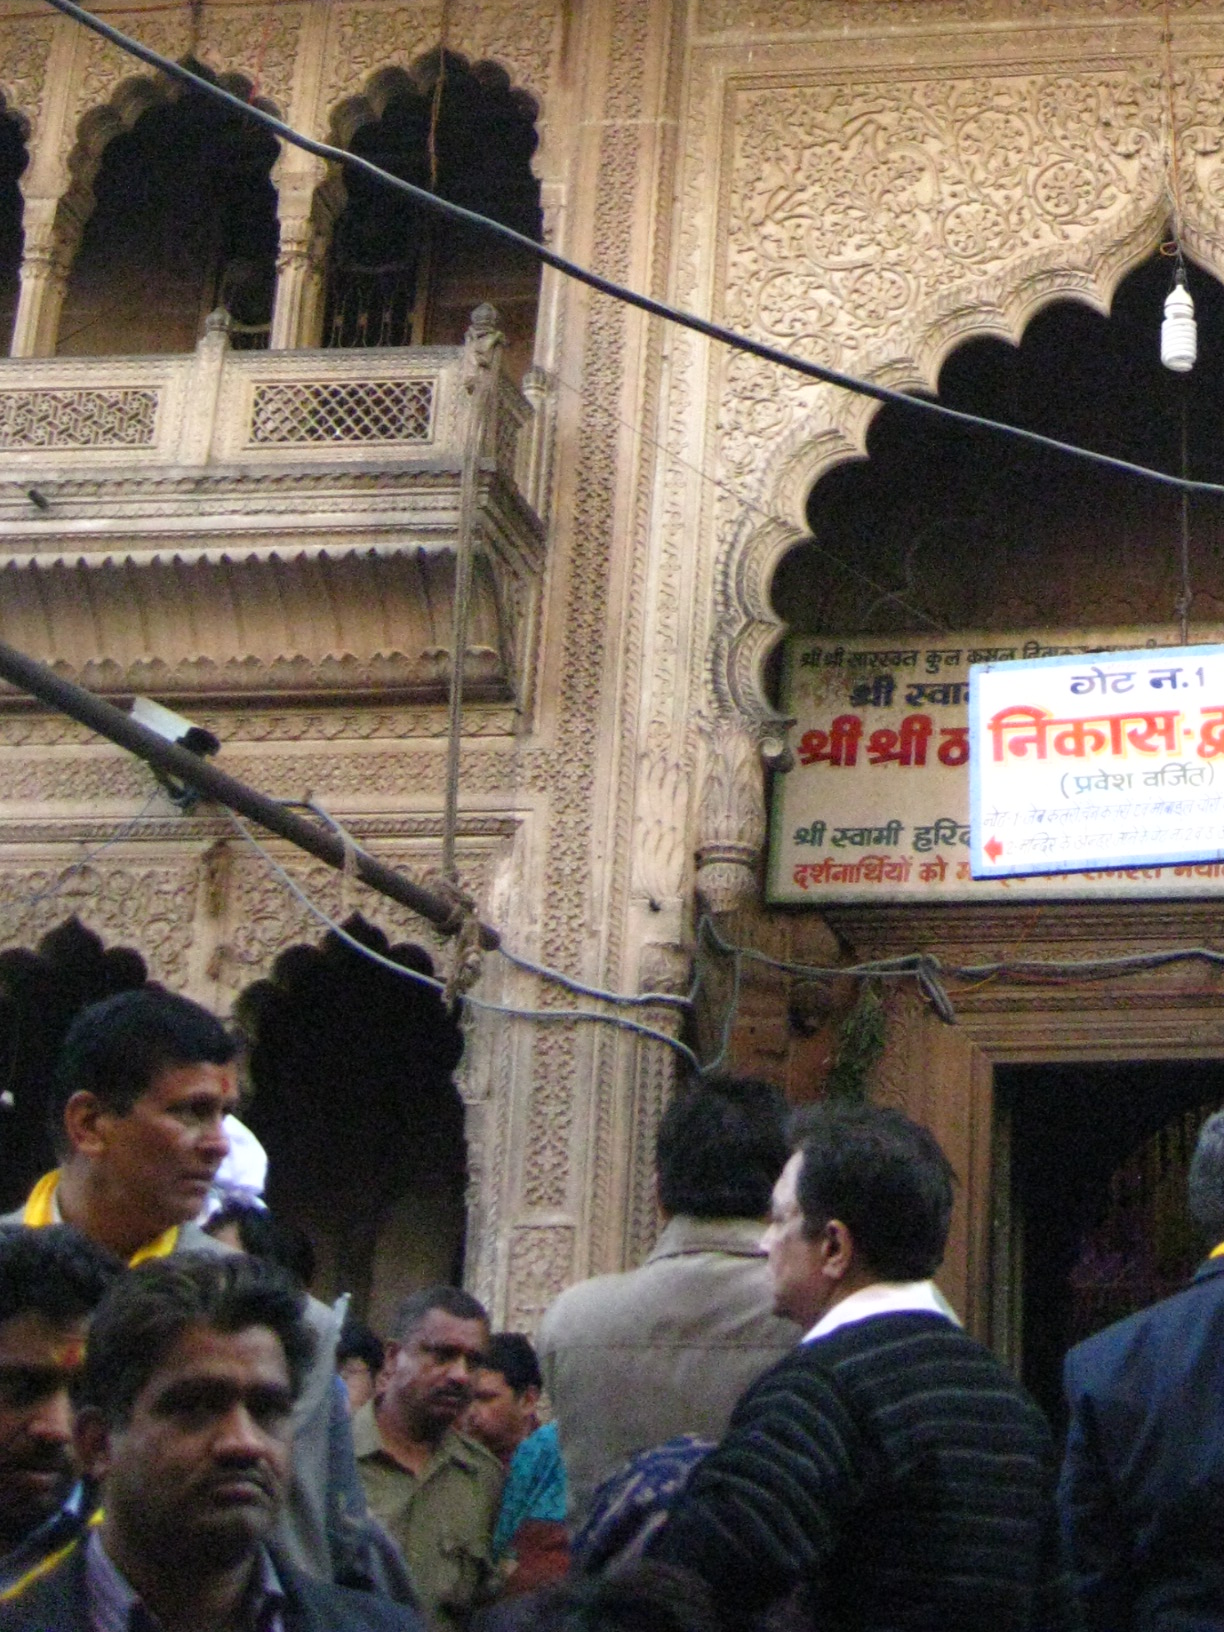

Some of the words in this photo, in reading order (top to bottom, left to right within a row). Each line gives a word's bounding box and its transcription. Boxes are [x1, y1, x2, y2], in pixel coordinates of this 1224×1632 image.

[850, 674, 896, 707] श्री
[1069, 666, 1137, 695] गेट
[797, 713, 863, 766] श्री
[866, 713, 932, 766] श्री
[793, 819, 827, 847] श्री
[831, 819, 905, 848] स्वामी
[918, 854, 949, 884] को
